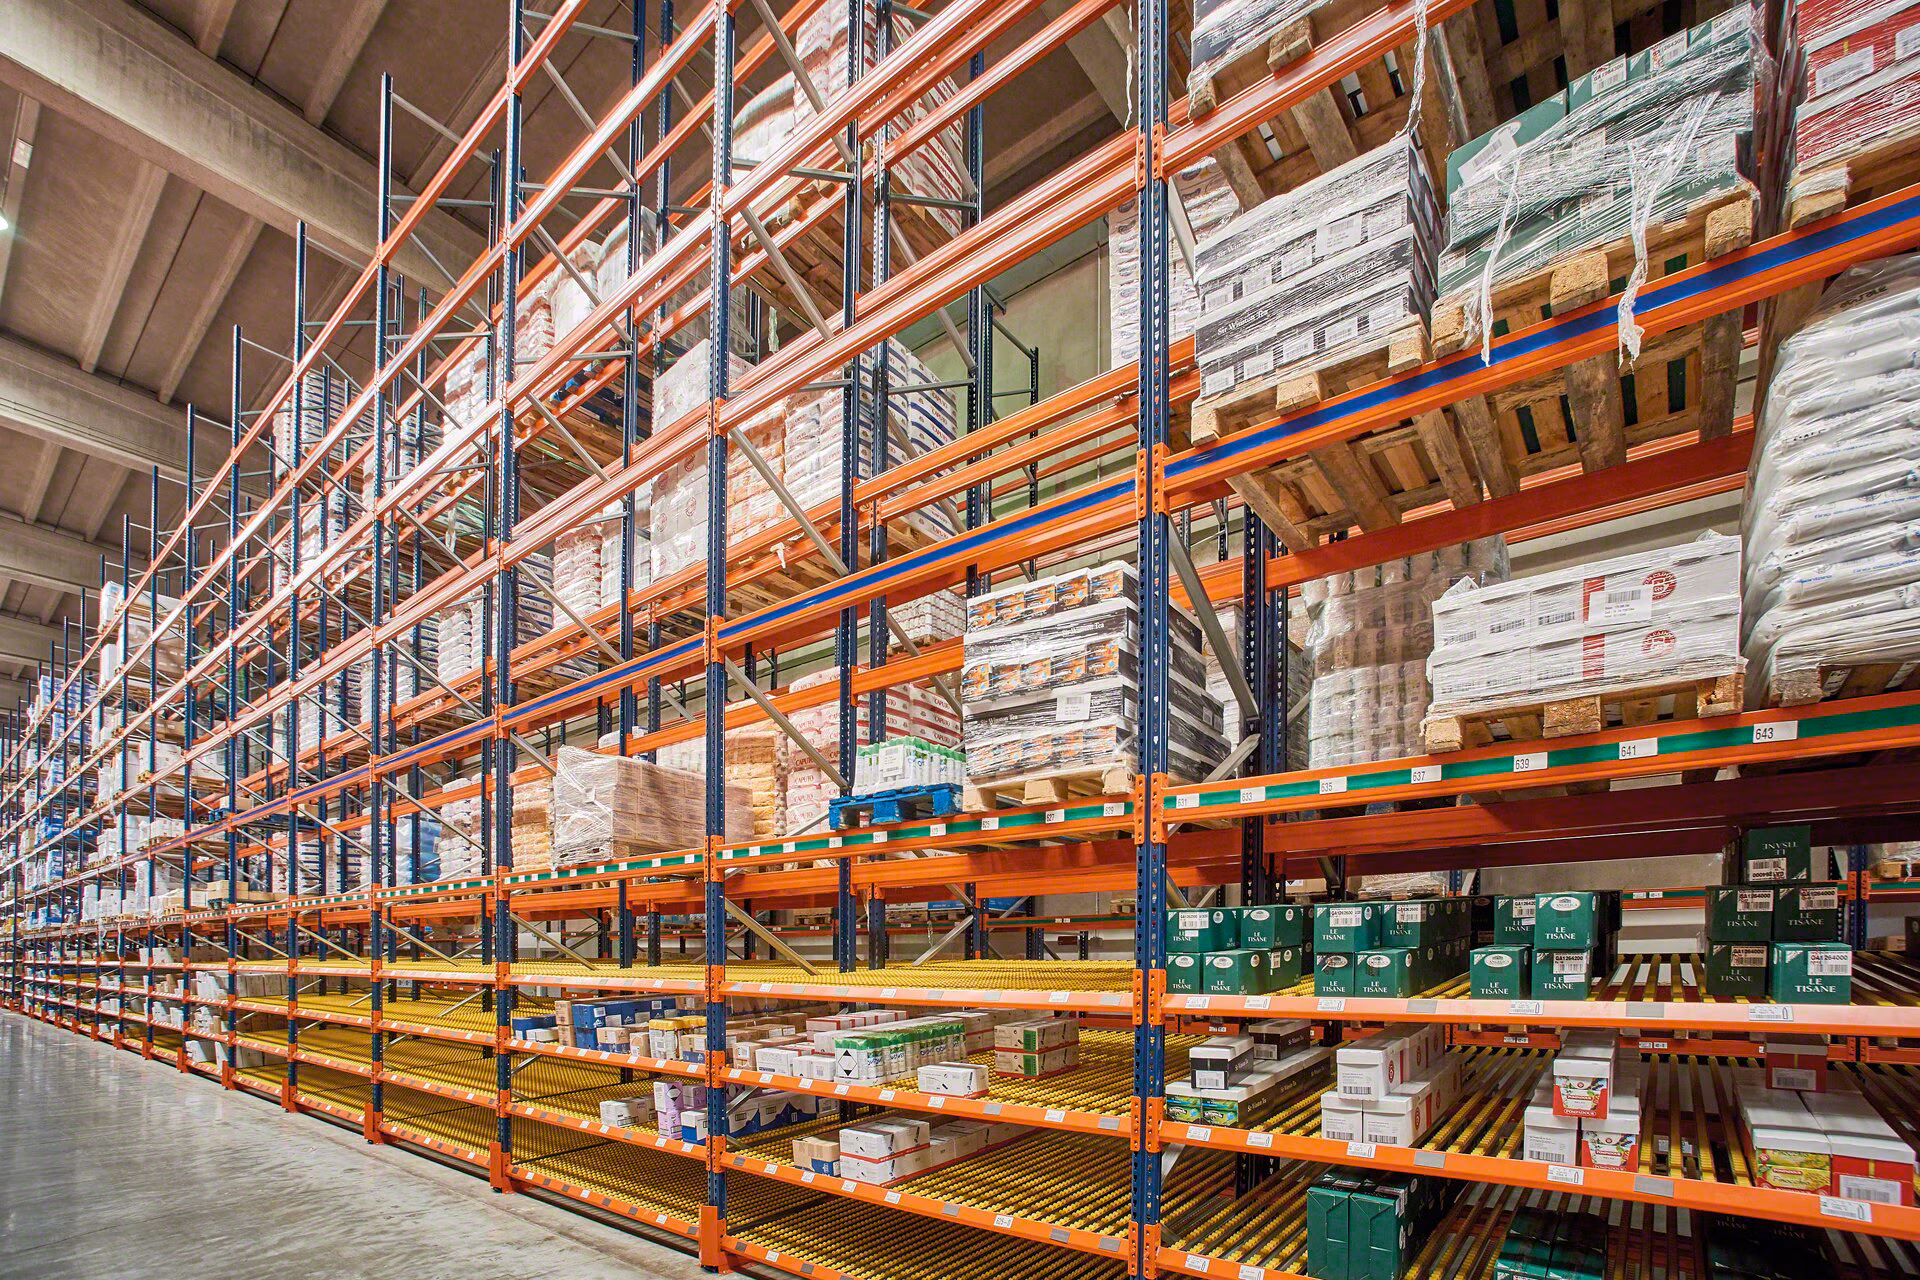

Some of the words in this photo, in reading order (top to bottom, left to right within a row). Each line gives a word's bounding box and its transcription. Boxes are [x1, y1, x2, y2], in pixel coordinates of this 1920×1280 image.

[1217, 324, 1228, 335] Sir
[1228, 315, 1255, 331] Winston
[1256, 310, 1268, 320] Tea
[1755, 727, 1774, 740] 643
[1621, 745, 1636, 757] 641
[1515, 758, 1530, 770] 639
[1412, 771, 1425, 782] 637
[1321, 782, 1333, 792] 635
[1177, 798, 1188, 807] 631
[1241, 792, 1252, 802] 633
[1795, 985, 1836, 993] TISANE
